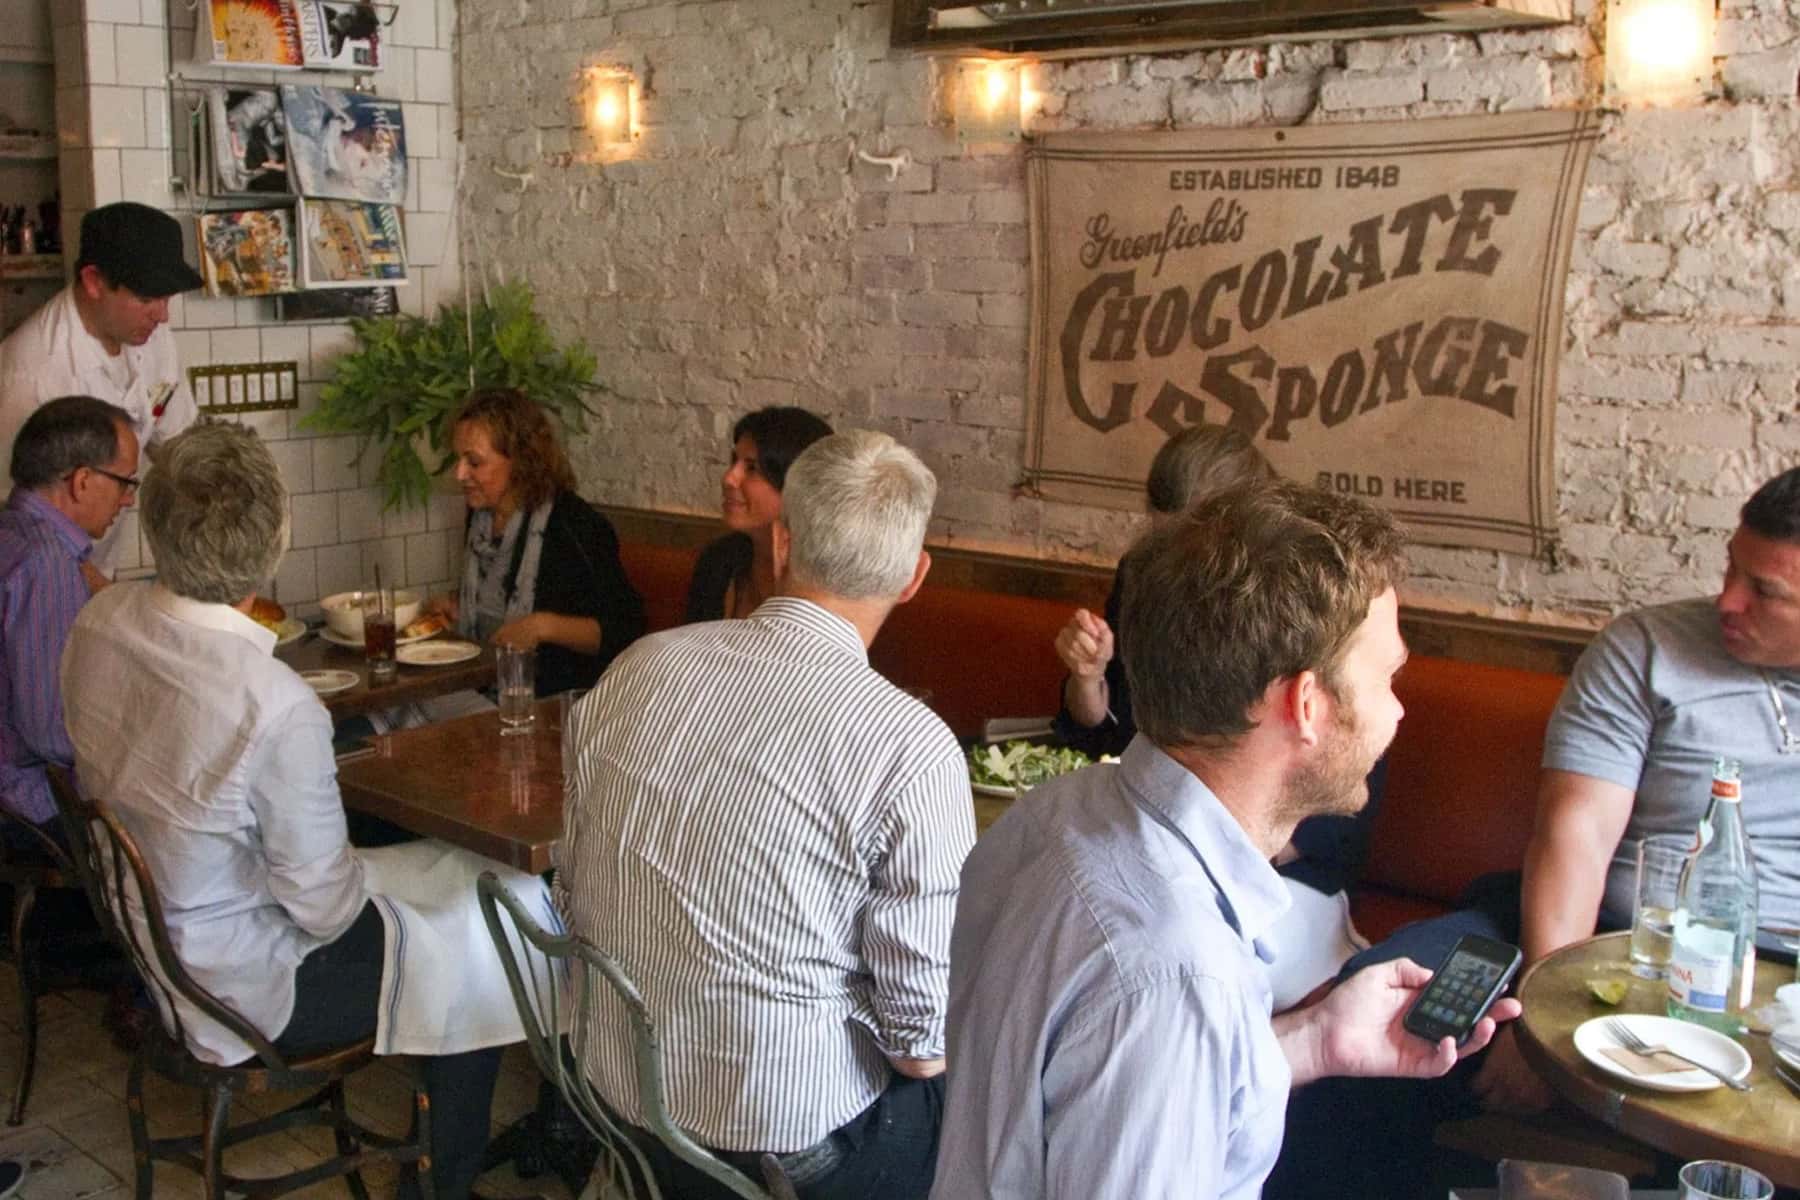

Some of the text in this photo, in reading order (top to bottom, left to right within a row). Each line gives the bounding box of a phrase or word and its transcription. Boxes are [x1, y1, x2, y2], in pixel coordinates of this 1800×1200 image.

[1169, 164, 1400, 192] ESTABLISHED 1848
[1079, 197, 1249, 278] Greenfield's
[1059, 187, 1518, 434] CHOCOLATE
[1145, 316, 1529, 442] SPONGE
[1317, 471, 1468, 503] SOLD HERE
